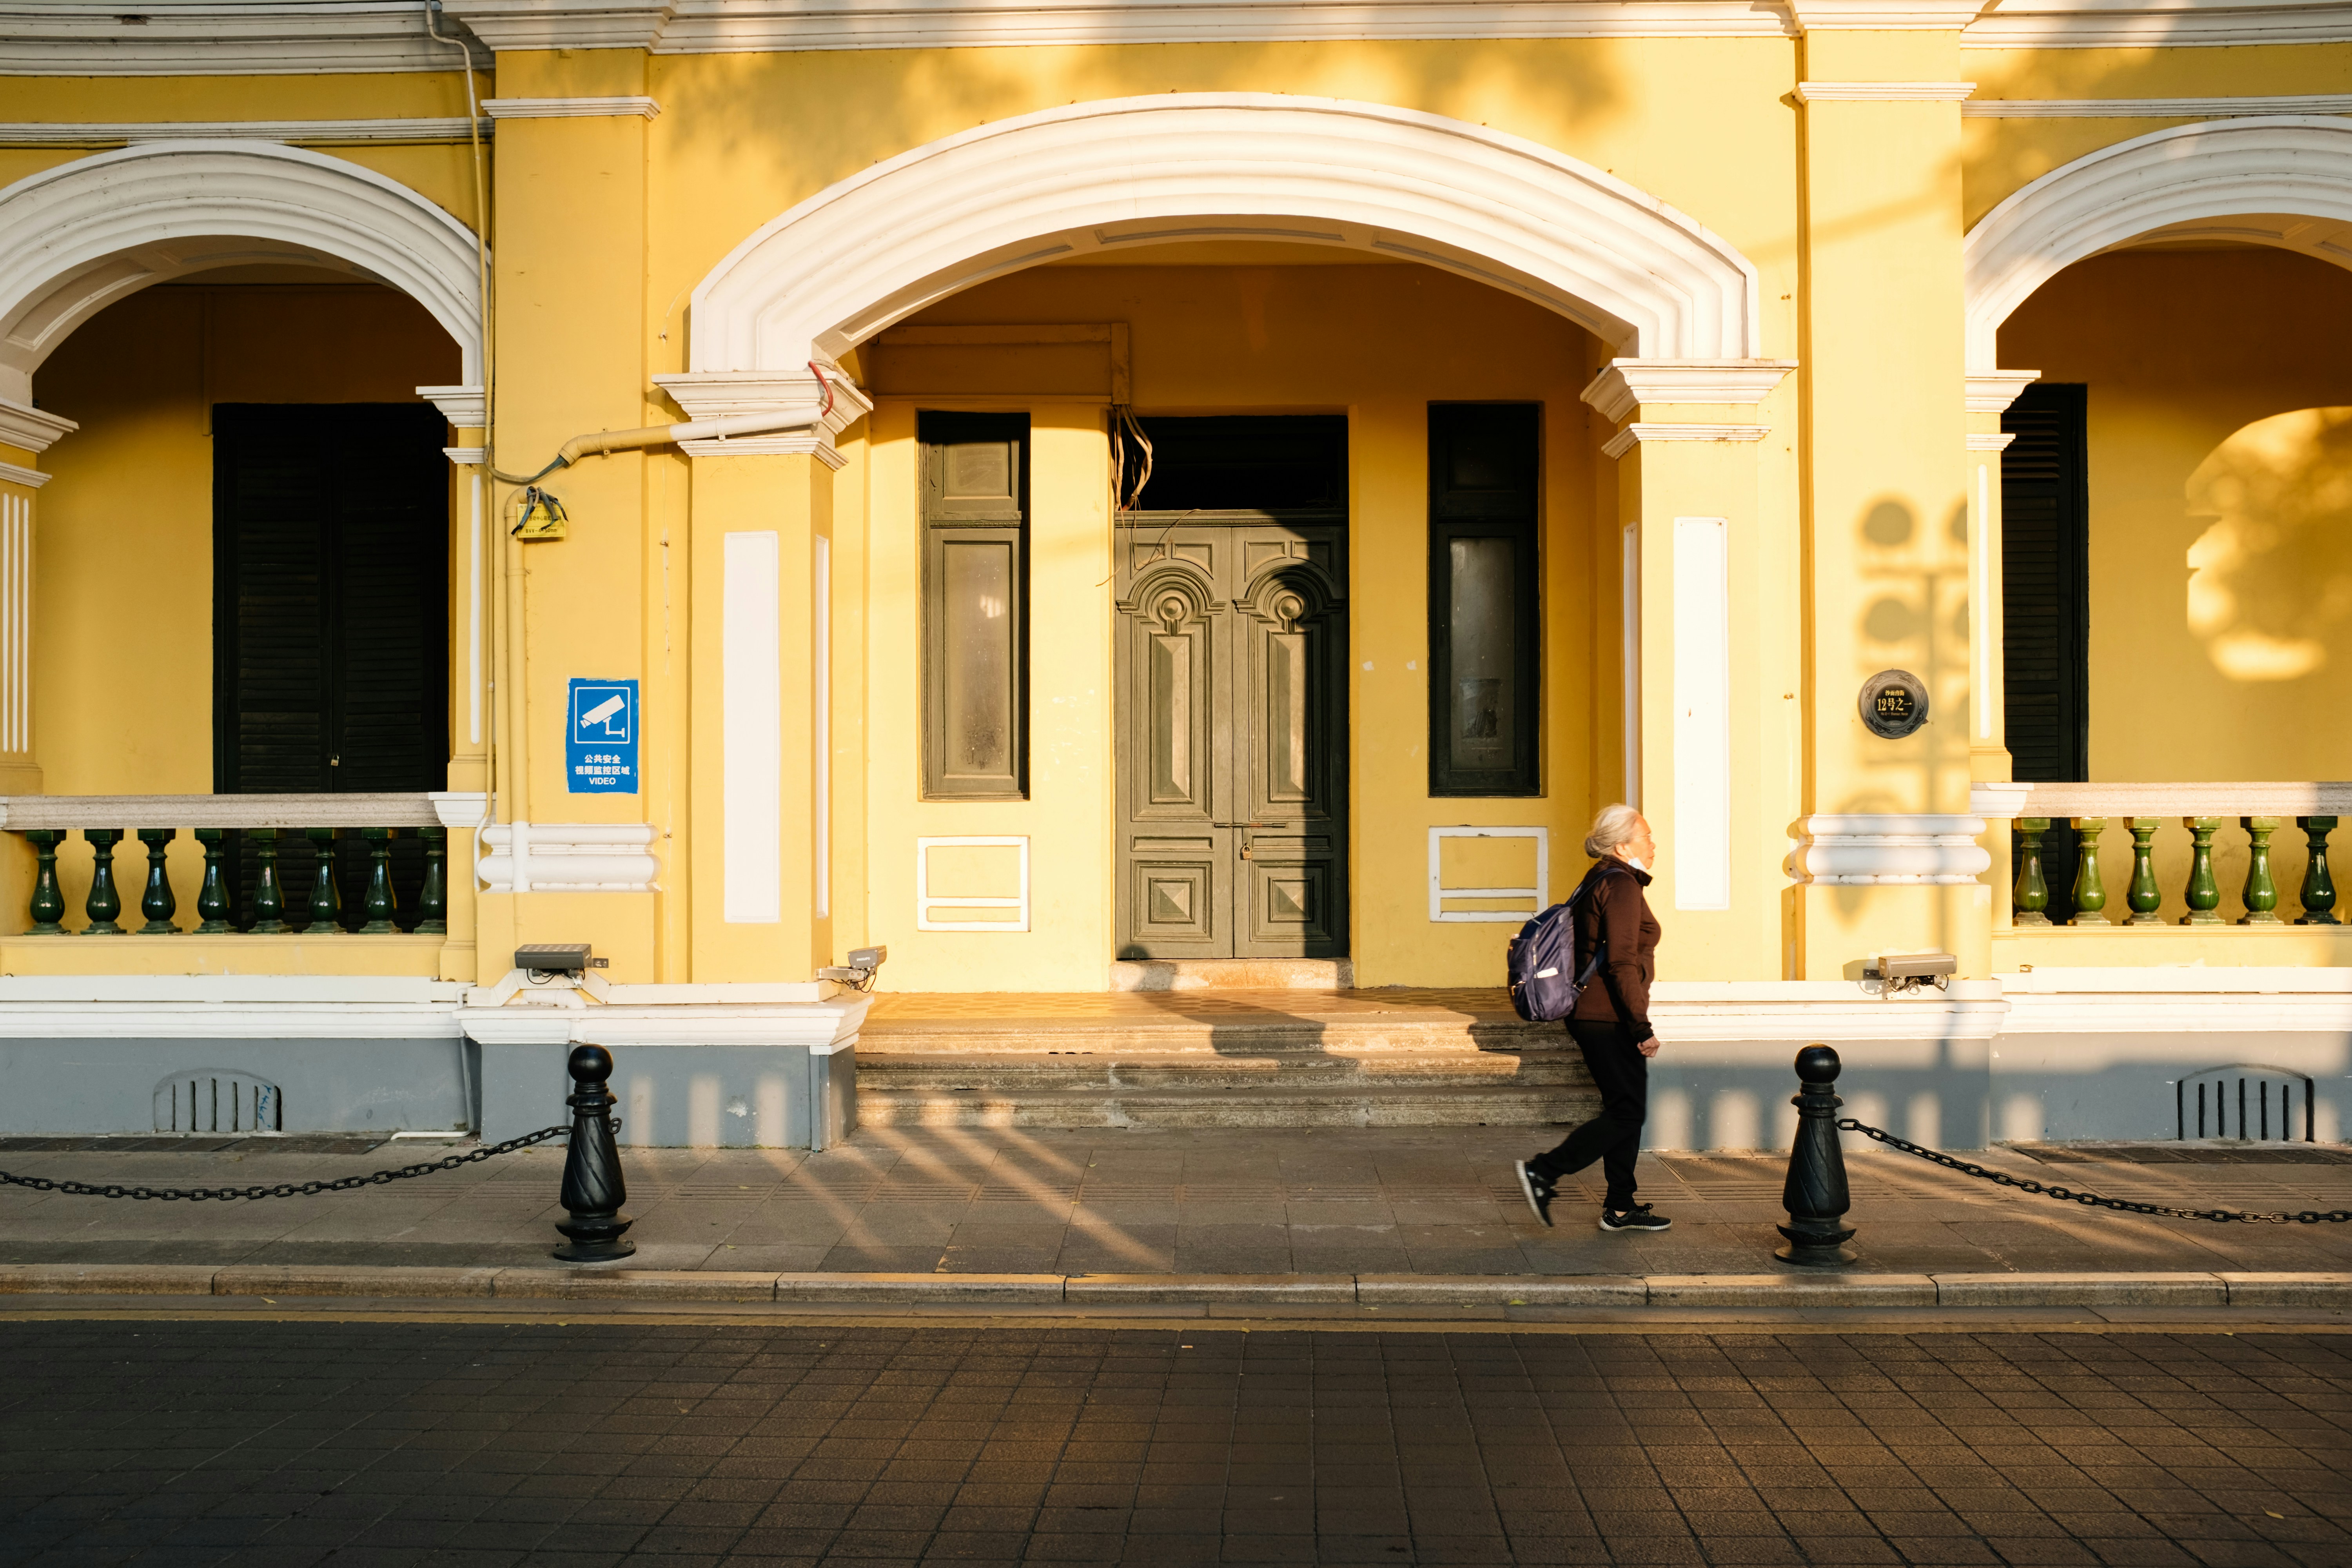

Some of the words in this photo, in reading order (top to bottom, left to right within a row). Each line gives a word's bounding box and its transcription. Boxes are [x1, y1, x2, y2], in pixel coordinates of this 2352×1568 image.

[1877, 698, 1912, 711] 12号之一
[584, 754, 621, 764] 公共安全
[575, 766, 630, 775] 视频监控区域
